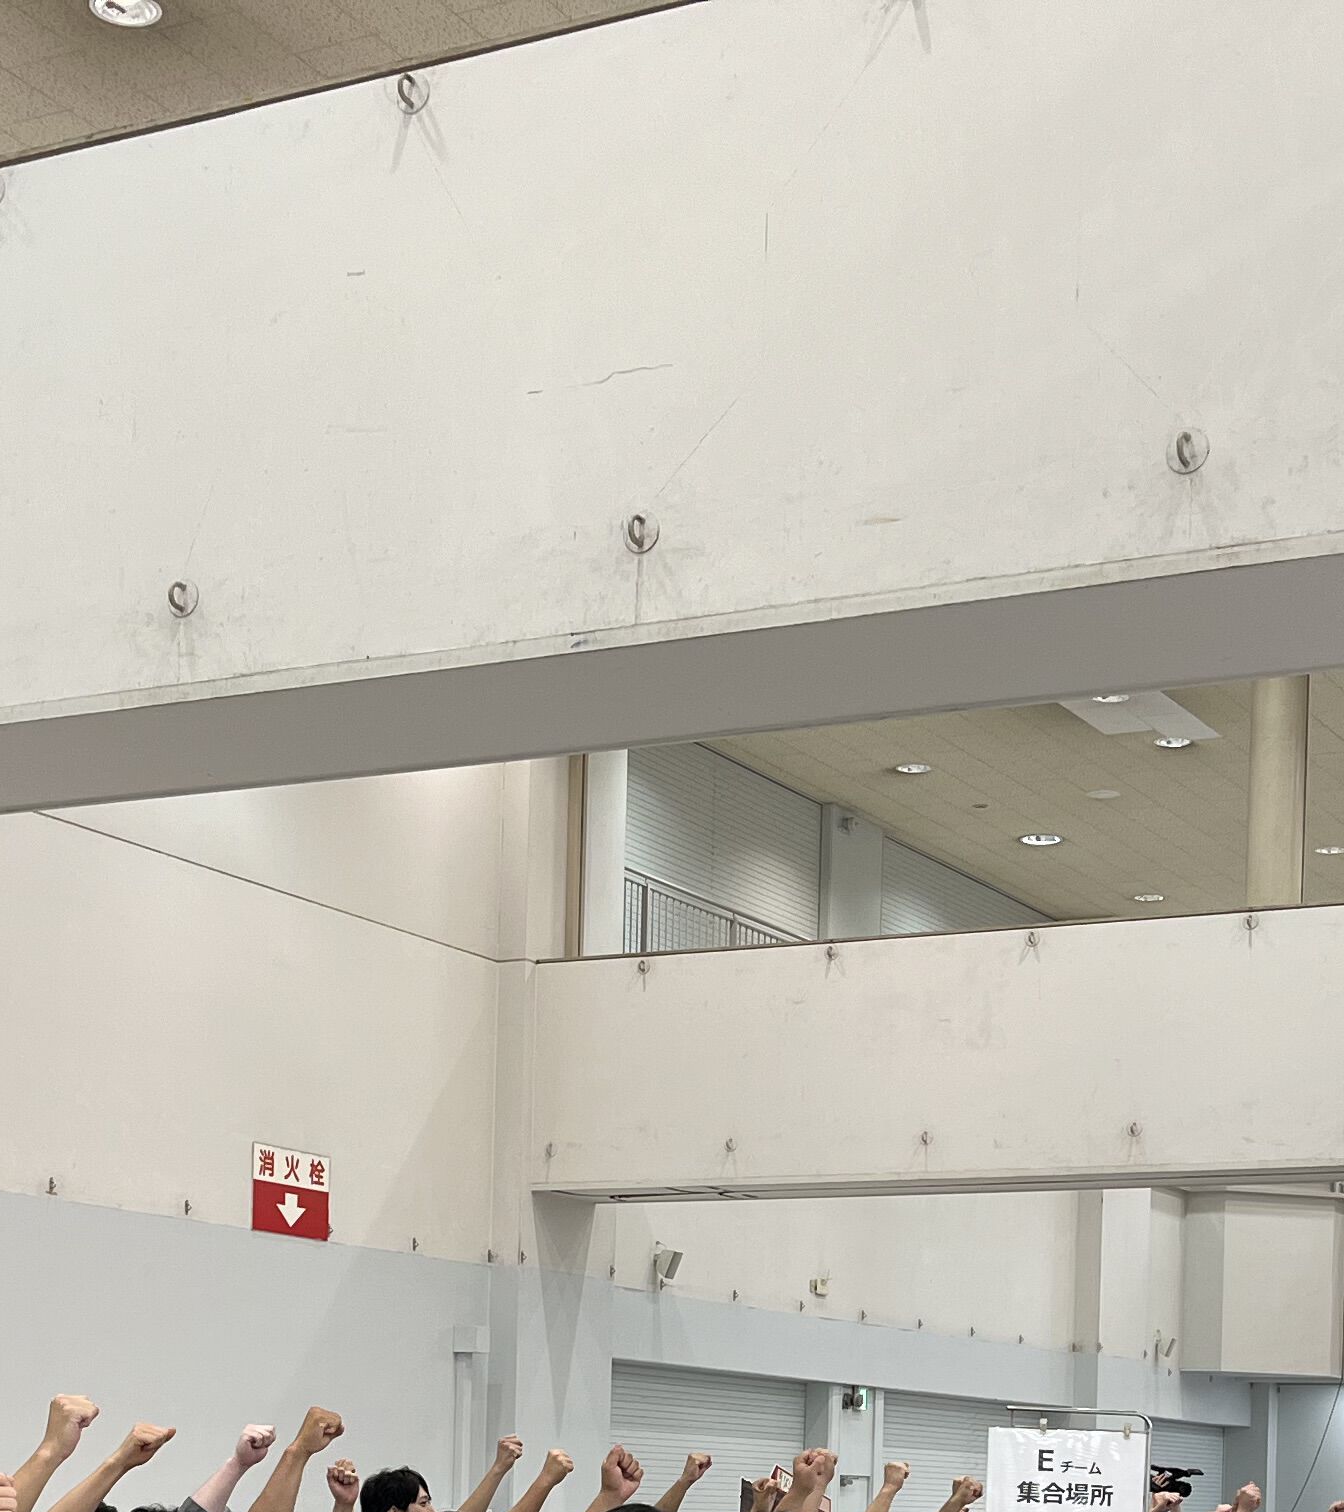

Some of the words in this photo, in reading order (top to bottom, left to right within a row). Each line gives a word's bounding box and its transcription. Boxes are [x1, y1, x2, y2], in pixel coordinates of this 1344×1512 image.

[258, 1148, 325, 1186] 消火栓
[1016, 1480, 1114, 1506] 集合場所
